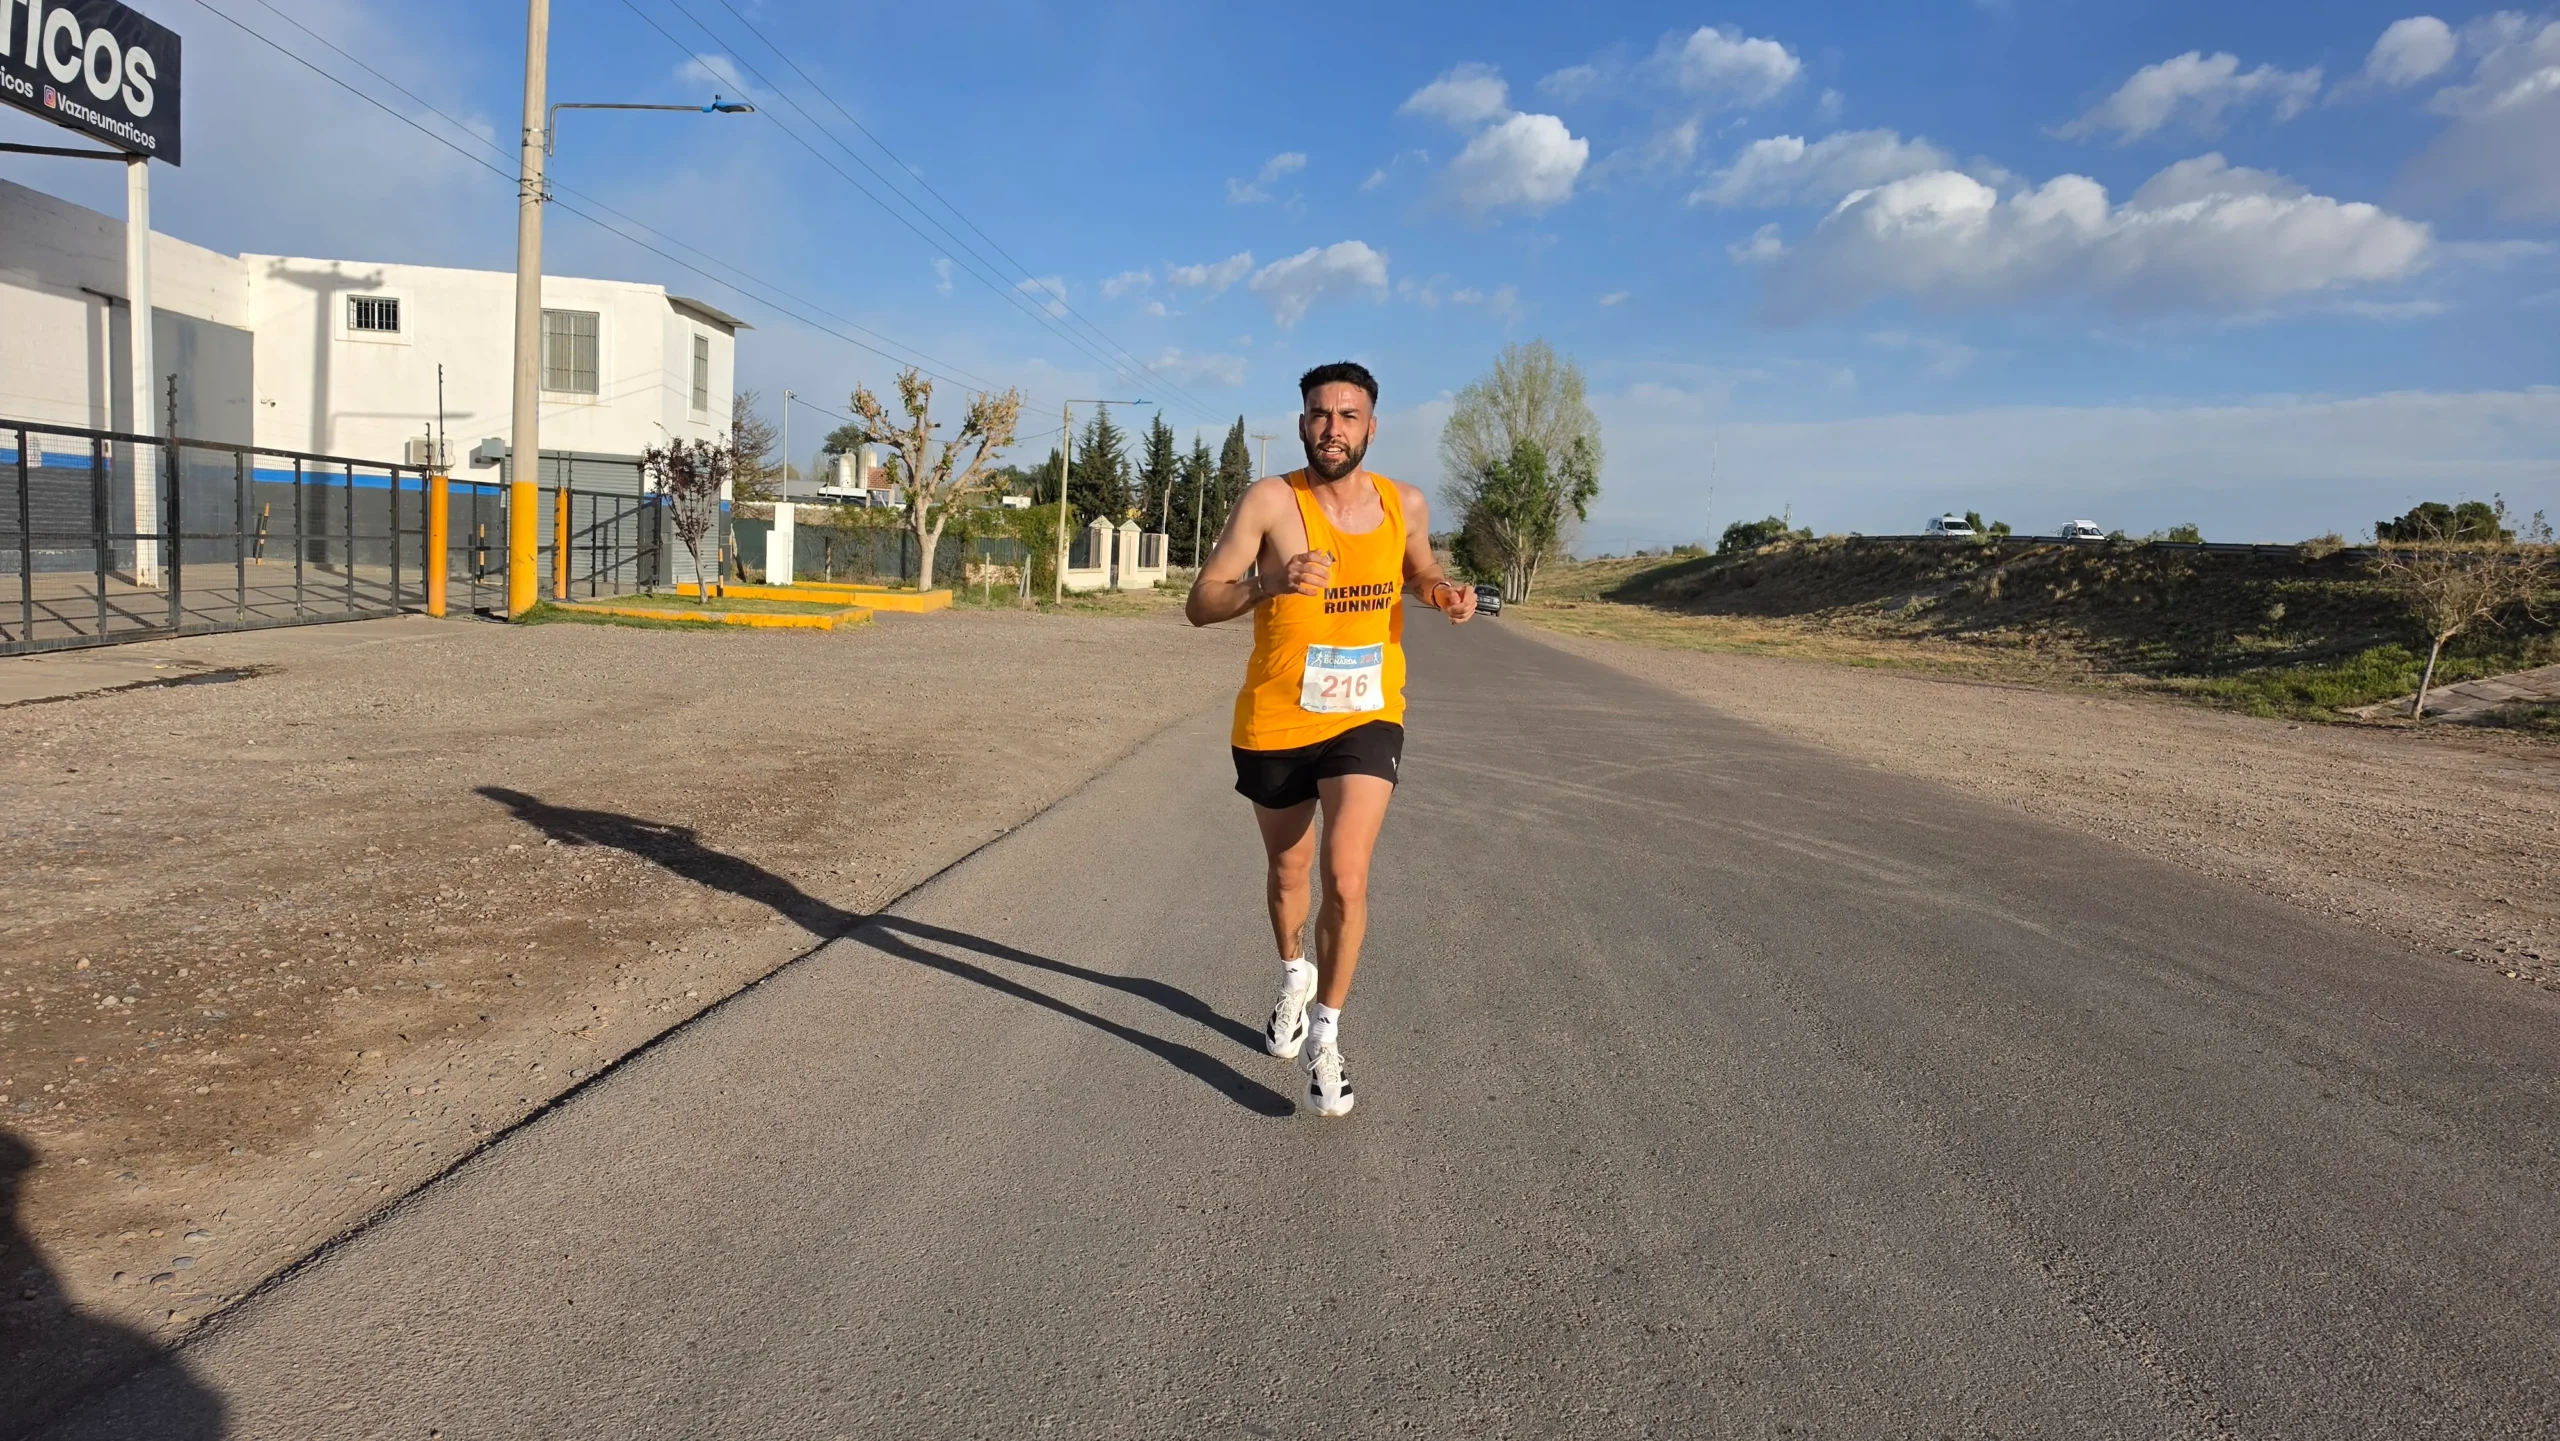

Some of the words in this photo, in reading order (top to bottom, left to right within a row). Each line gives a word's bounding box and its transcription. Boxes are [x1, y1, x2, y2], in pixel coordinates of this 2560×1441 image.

[0, 66, 33, 98] icos
[57, 92, 156, 149] Vazneumaticos
[1324, 581, 1394, 600] MENDOZA
[1323, 657, 1358, 665] BONARDA
[1320, 673, 1369, 699] 216
